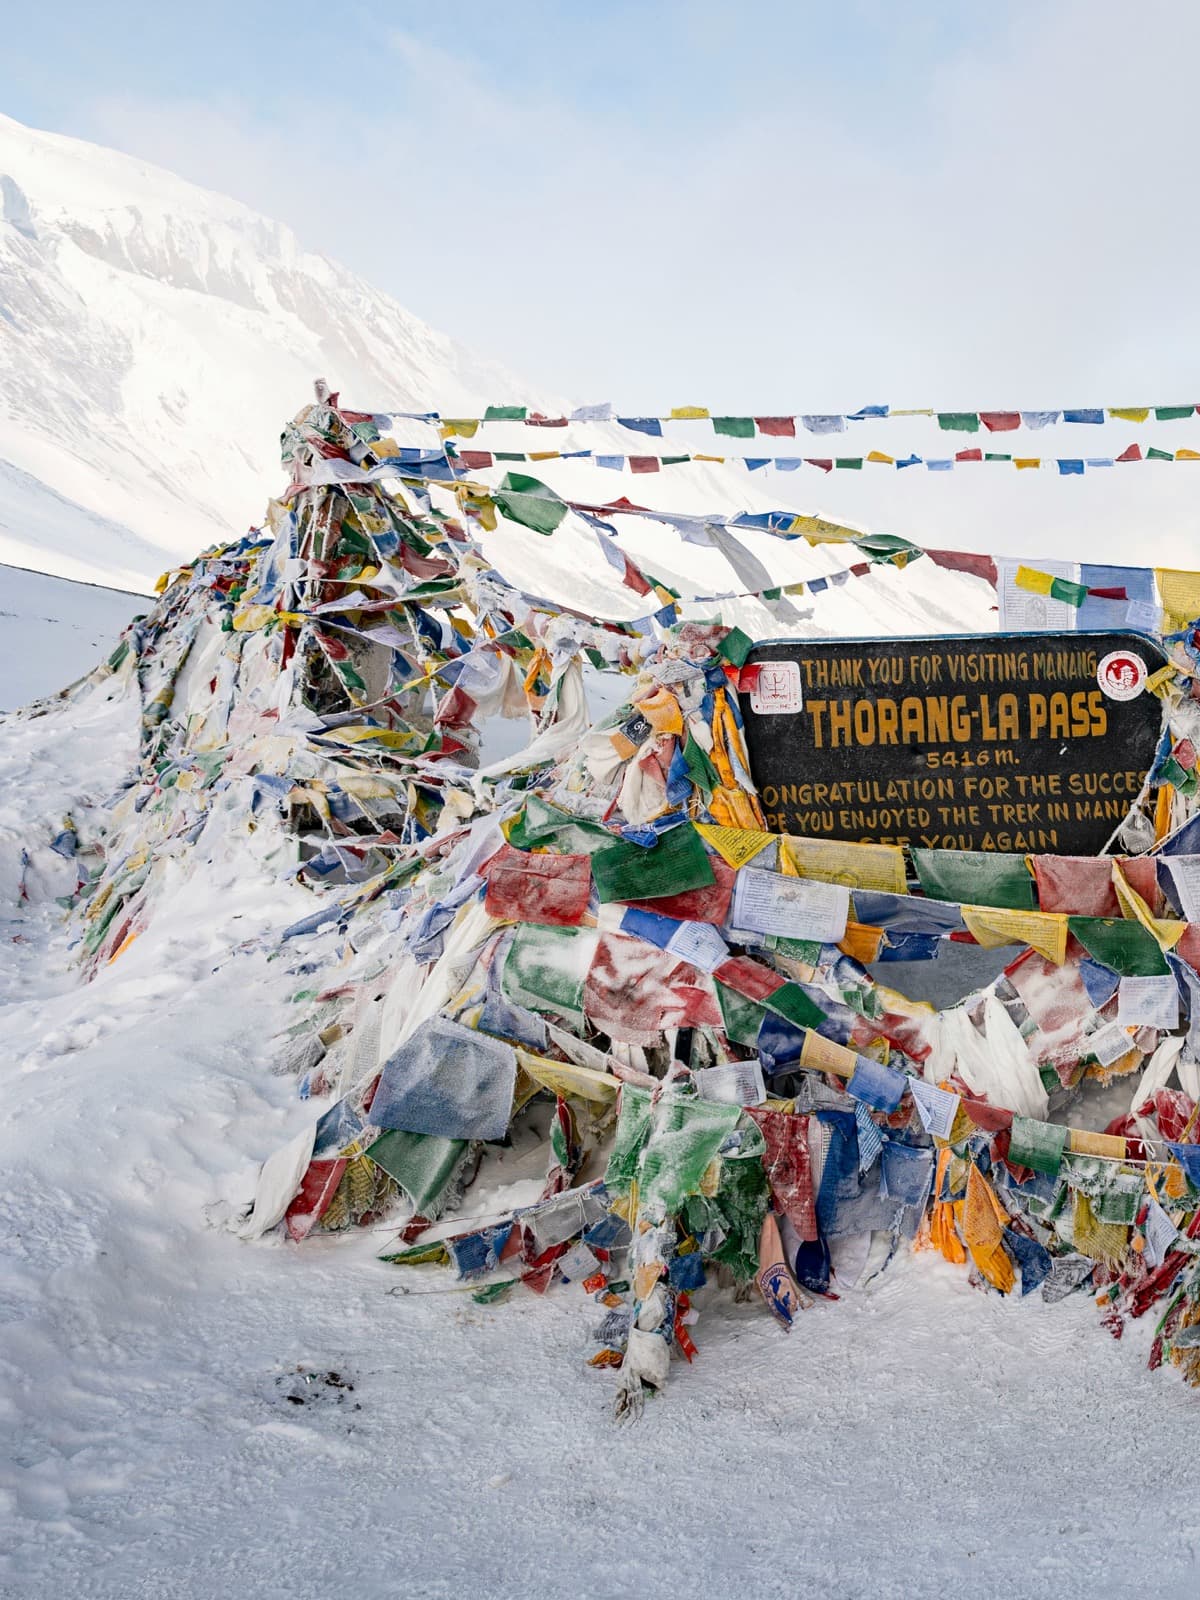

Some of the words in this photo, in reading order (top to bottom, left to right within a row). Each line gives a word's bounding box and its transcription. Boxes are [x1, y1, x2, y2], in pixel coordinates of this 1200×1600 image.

[801, 657, 865, 688] THANK
[868, 656, 904, 685] YOU
[910, 654, 943, 683] FOR
[946, 651, 1028, 683] VISITING
[1032, 650, 1097, 681] MANANG
[806, 693, 1020, 748] THORANG-LA
[1028, 690, 1108, 740] PASS
[926, 750, 990, 769] 5416
[762, 778, 955, 808] ONGRATULATION
[963, 776, 1013, 800] FOR
[1014, 774, 1063, 798] THE
[766, 812, 789, 833] PE
[795, 810, 835, 833] YOU
[839, 807, 931, 830] ENJOYED
[937, 804, 981, 827] THE
[987, 803, 1044, 826] TREK
[1047, 801, 1070, 822] IN
[1075, 799, 1133, 821] MANA
[920, 833, 973, 851] YOU
[981, 829, 1058, 852] AGAIN
